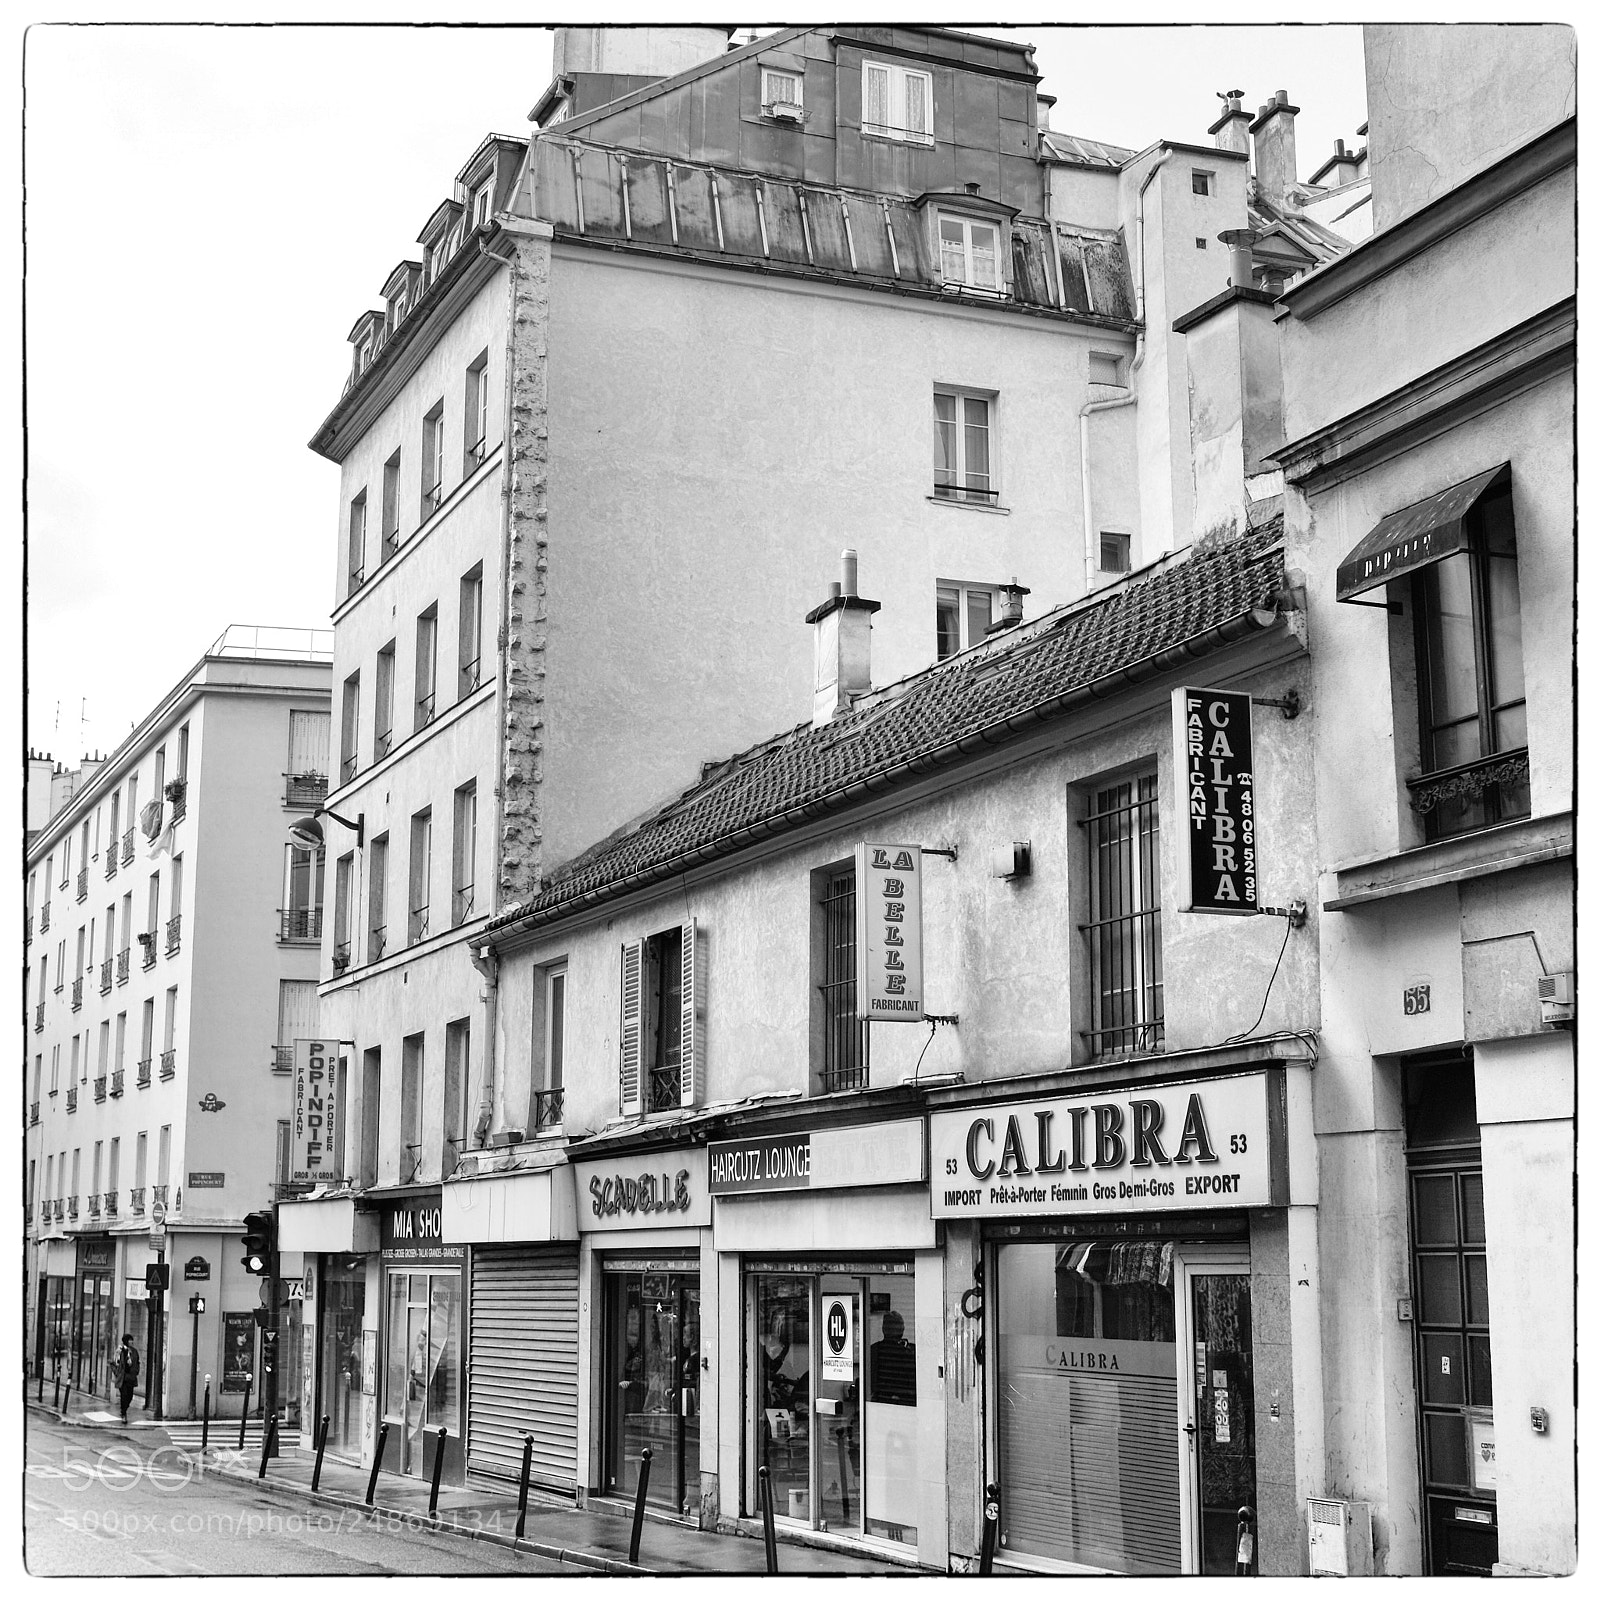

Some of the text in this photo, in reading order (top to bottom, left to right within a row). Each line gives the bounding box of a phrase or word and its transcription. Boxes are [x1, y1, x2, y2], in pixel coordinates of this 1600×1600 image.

[1187, 698, 1207, 830] FABRICANT
[1208, 701, 1240, 901] CALIBRA
[871, 849, 914, 871] LA
[882, 878, 907, 995] BELLE
[871, 998, 919, 1012] FABRICANT
[1405, 985, 1429, 1014] 55
[296, 1067, 305, 1140] FABRICANT
[307, 1043, 325, 1169] POPINDIFF
[327, 1092, 334, 1101] A
[326, 1104, 334, 1152] PORTER
[965, 1092, 1219, 1181] CALIBRA
[1229, 1134, 1248, 1155] 53
[294, 1171, 308, 1179] GROS
[318, 1171, 334, 1180] GROS
[710, 1143, 810, 1183] HAIRCUTZ LOUNGE
[945, 1158, 958, 1176] 53
[589, 1168, 690, 1215] SCADELLE
[944, 1174, 1241, 1207] IMPORT Prêt-à-Porter Féminin Gros Demi-Gros EXPORT
[393, 1210, 413, 1239] MIA
[830, 1315, 845, 1337] HL
[1045, 1344, 1120, 1370] CALIBRA
